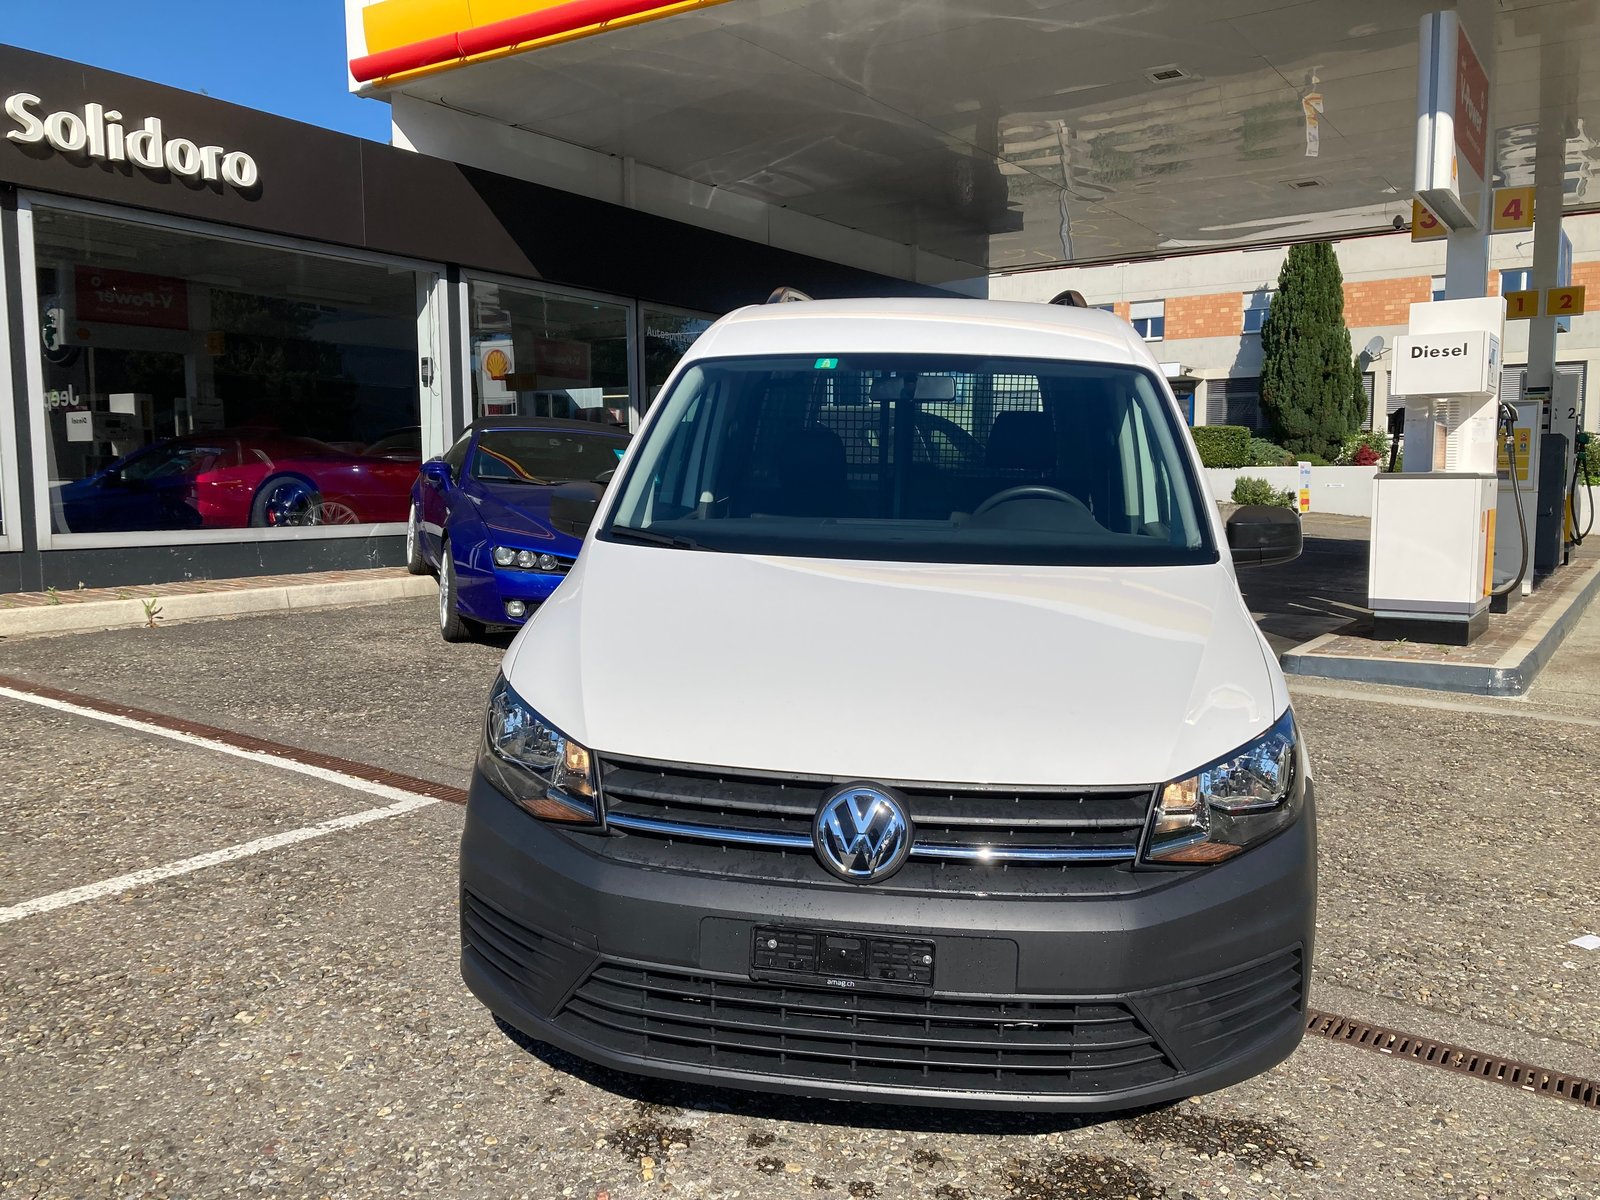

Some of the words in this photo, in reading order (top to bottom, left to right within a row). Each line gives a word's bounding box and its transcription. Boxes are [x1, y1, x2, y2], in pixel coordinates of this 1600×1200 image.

[5, 92, 258, 188] Solidoro
[1502, 198, 1523, 221] 4
[1419, 208, 1438, 229] 3
[1516, 297, 1524, 312] 1
[1559, 294, 1573, 309] 2
[1411, 342, 1468, 359] Diesel
[1567, 407, 1576, 419] 2
[826, 979, 855, 988] amag.ch
